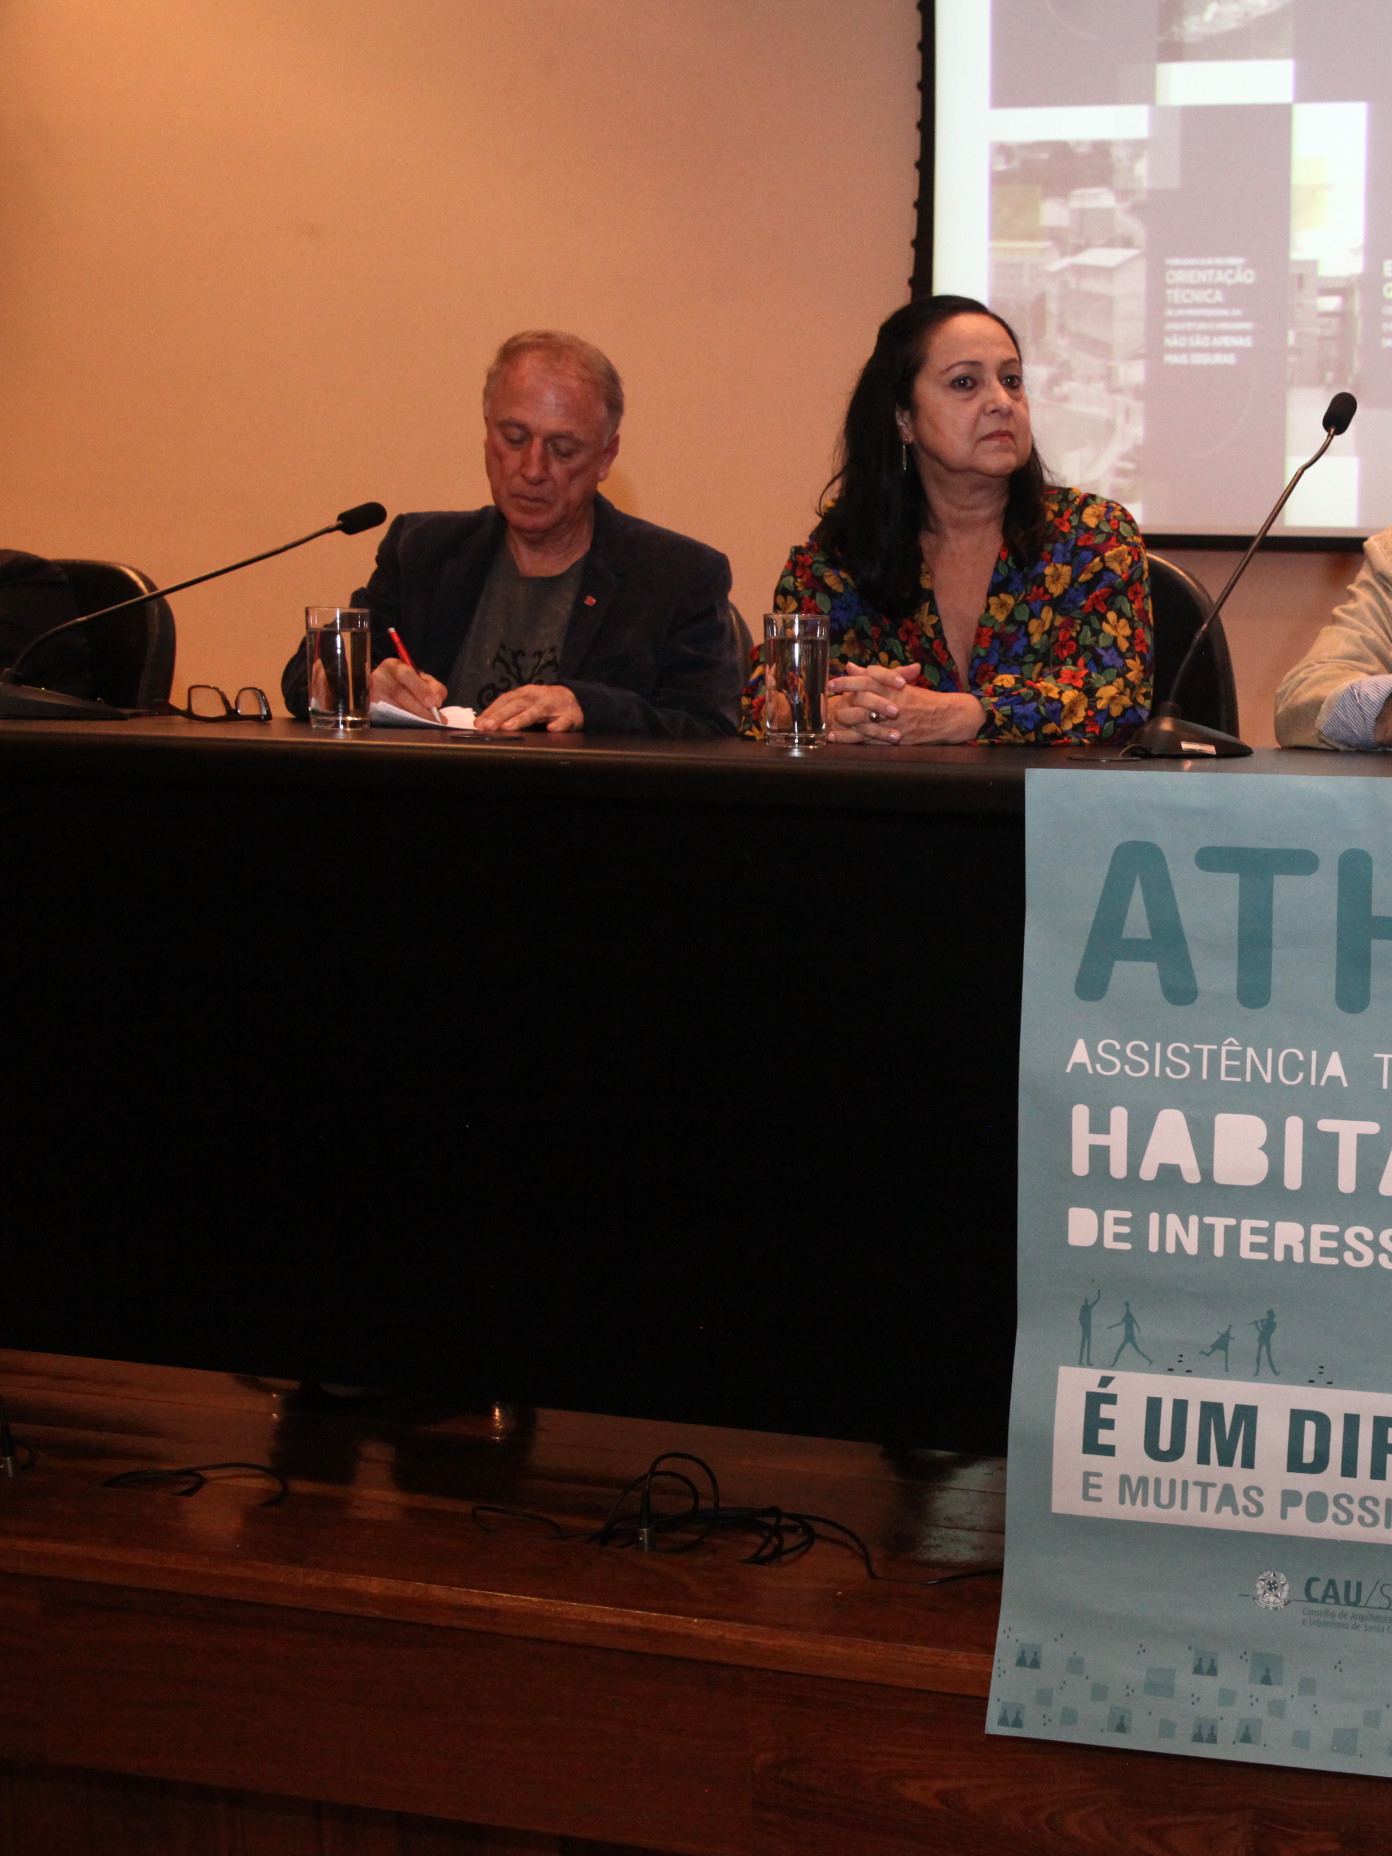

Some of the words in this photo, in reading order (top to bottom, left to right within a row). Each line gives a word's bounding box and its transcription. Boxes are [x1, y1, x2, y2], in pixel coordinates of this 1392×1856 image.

[1165, 265, 1255, 285] ORIENTAÇÃO
[1165, 284, 1224, 304] TÉCNICA
[1066, 1037, 1348, 1088] ASSISTÊNCIA
[1067, 1207, 1133, 1250] DE
[1082, 1376, 1119, 1458] É
[1143, 1395, 1259, 1470] UM
[1081, 1471, 1104, 1503] E
[1118, 1473, 1265, 1519] MUITAS
[1302, 1607, 1336, 1619] Conselho
[1339, 1610, 1348, 1620] de
[1350, 1612, 1392, 1624] Arquitetura
[1309, 1619, 1349, 1631] Urbanismo
[1351, 1621, 1361, 1631] de
[1363, 1623, 1385, 1634] Santa
